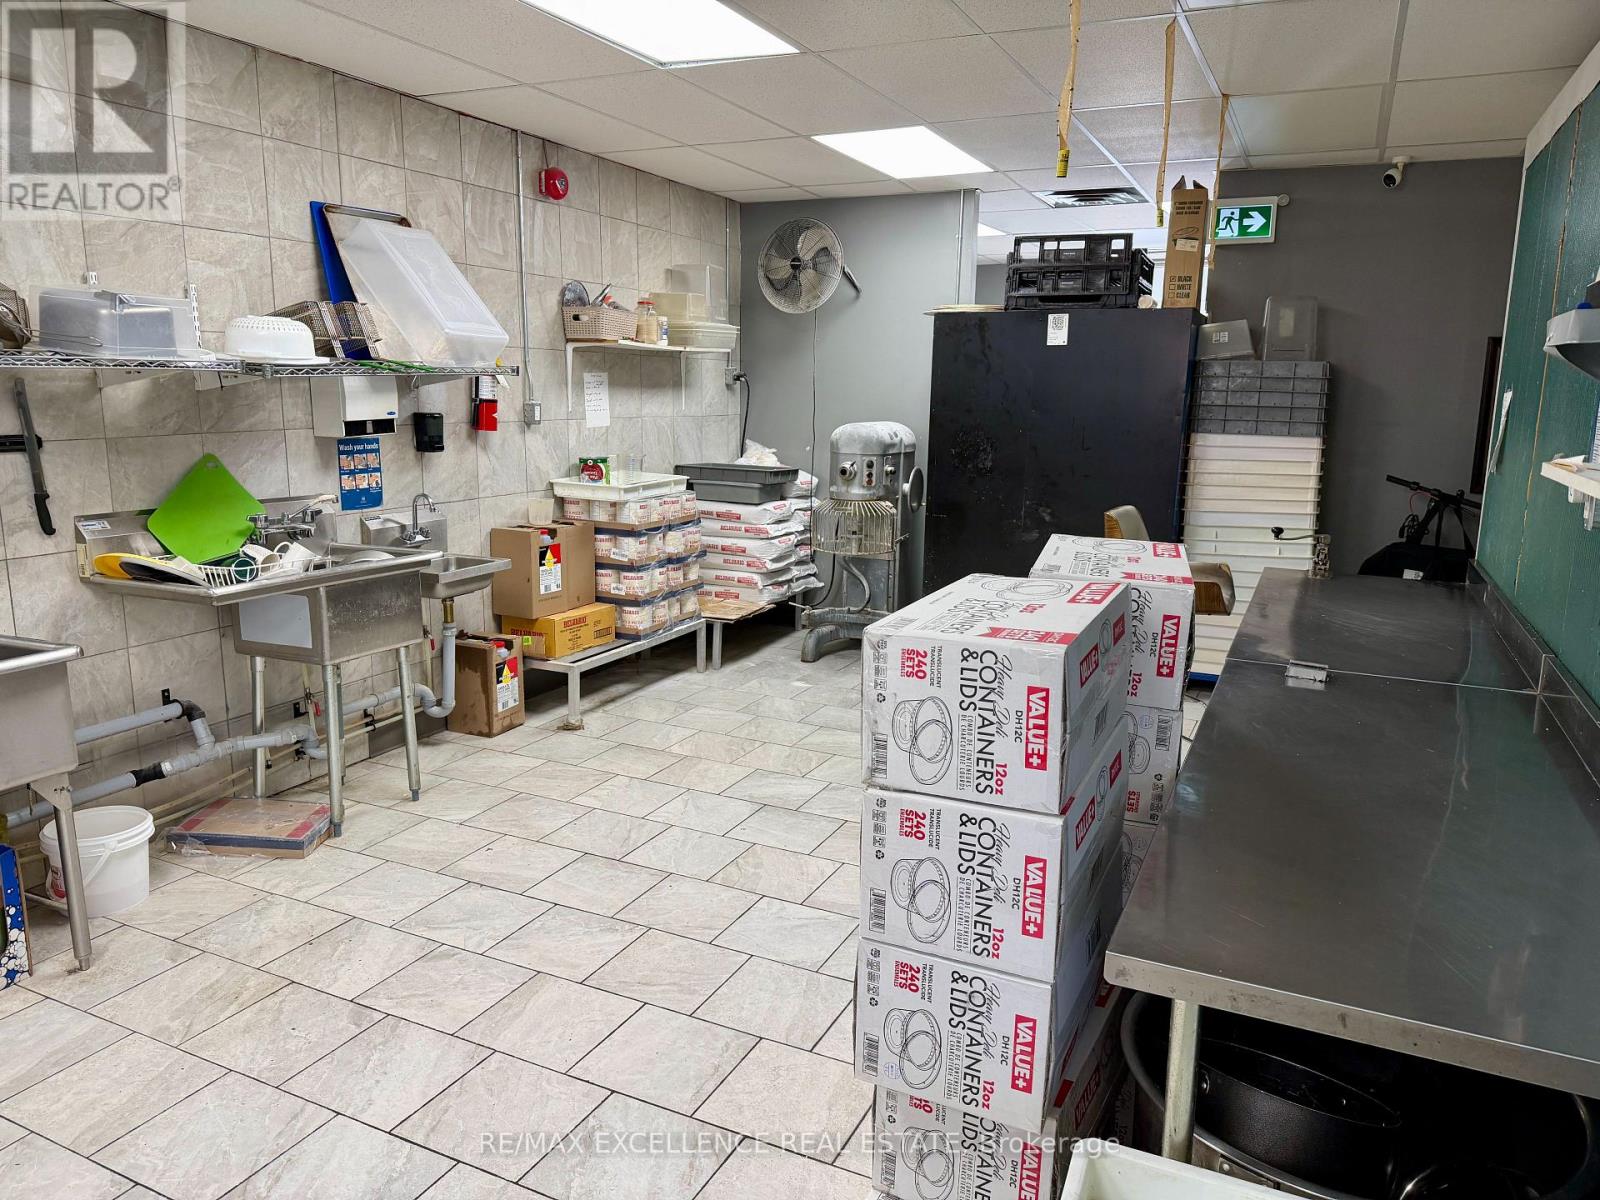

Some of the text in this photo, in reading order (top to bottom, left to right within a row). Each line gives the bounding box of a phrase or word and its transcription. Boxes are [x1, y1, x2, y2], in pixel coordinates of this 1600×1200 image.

[1135, 591, 1152, 654] Heavy Deli
[1150, 632, 1158, 658] DH12C
[1159, 618, 1177, 675] VALUE+
[906, 649, 914, 678] SETS
[915, 650, 927, 679] 240
[959, 648, 978, 711] & LIDS
[990, 655, 1012, 738] Heavy Deli
[1131, 673, 1142, 697] 12oz
[976, 650, 997, 794] CONTAINERS
[1015, 710, 1023, 743] DH12C
[1028, 692, 1047, 766] VALUE+
[995, 763, 1007, 795] 12oz
[1127, 790, 1136, 812] SETS
[905, 809, 913, 837] SETS
[915, 811, 926, 840] 240
[958, 814, 977, 875] & LIDS
[990, 823, 1010, 904] Heavy Deli
[973, 818, 996, 957] CONTAINERS
[1012, 878, 1021, 909] DH12C
[1025, 862, 1043, 934] VALUE+
[992, 928, 1004, 959] 12oz
[899, 962, 908, 989] SETS
[908, 964, 920, 992] 240
[949, 971, 968, 1030] & LIDS
[980, 983, 1000, 1060] Heavy Deli
[962, 977, 986, 1106] CONTAINERS
[1001, 1036, 1010, 1066] DH12C
[1014, 1021, 1033, 1088] VALUE+
[982, 1080, 994, 1110] 12oz
[961, 1112, 979, 1152] LIDS
[1010, 1160, 1018, 1188] DH12C
[1021, 1146, 1040, 1200] VALUE
